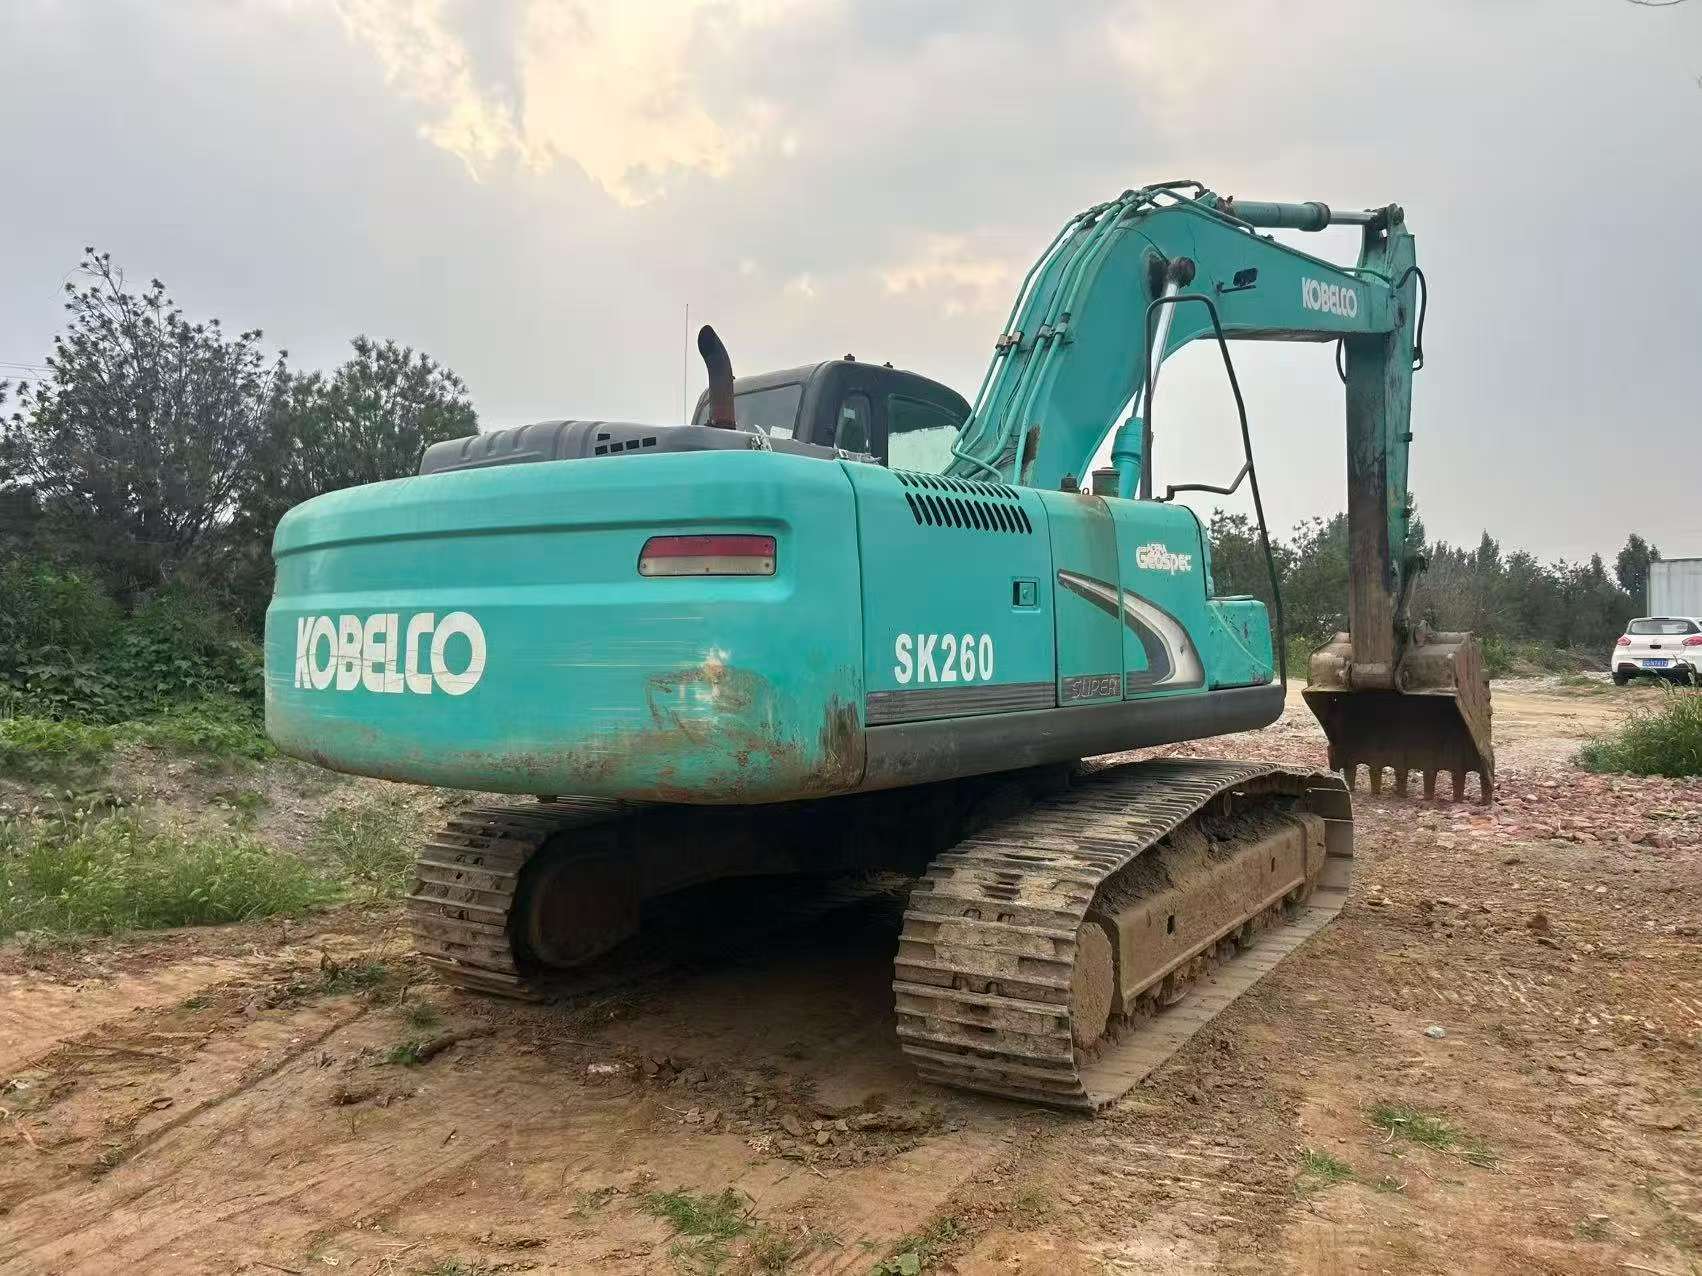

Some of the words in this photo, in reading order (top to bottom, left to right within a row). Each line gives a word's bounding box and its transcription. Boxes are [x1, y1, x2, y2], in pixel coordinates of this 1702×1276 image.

[1301, 276, 1358, 318] KOBELCO
[294, 611, 487, 696] KOBELCO
[894, 633, 994, 684] SK260
[1071, 678, 1118, 699] SUPER
